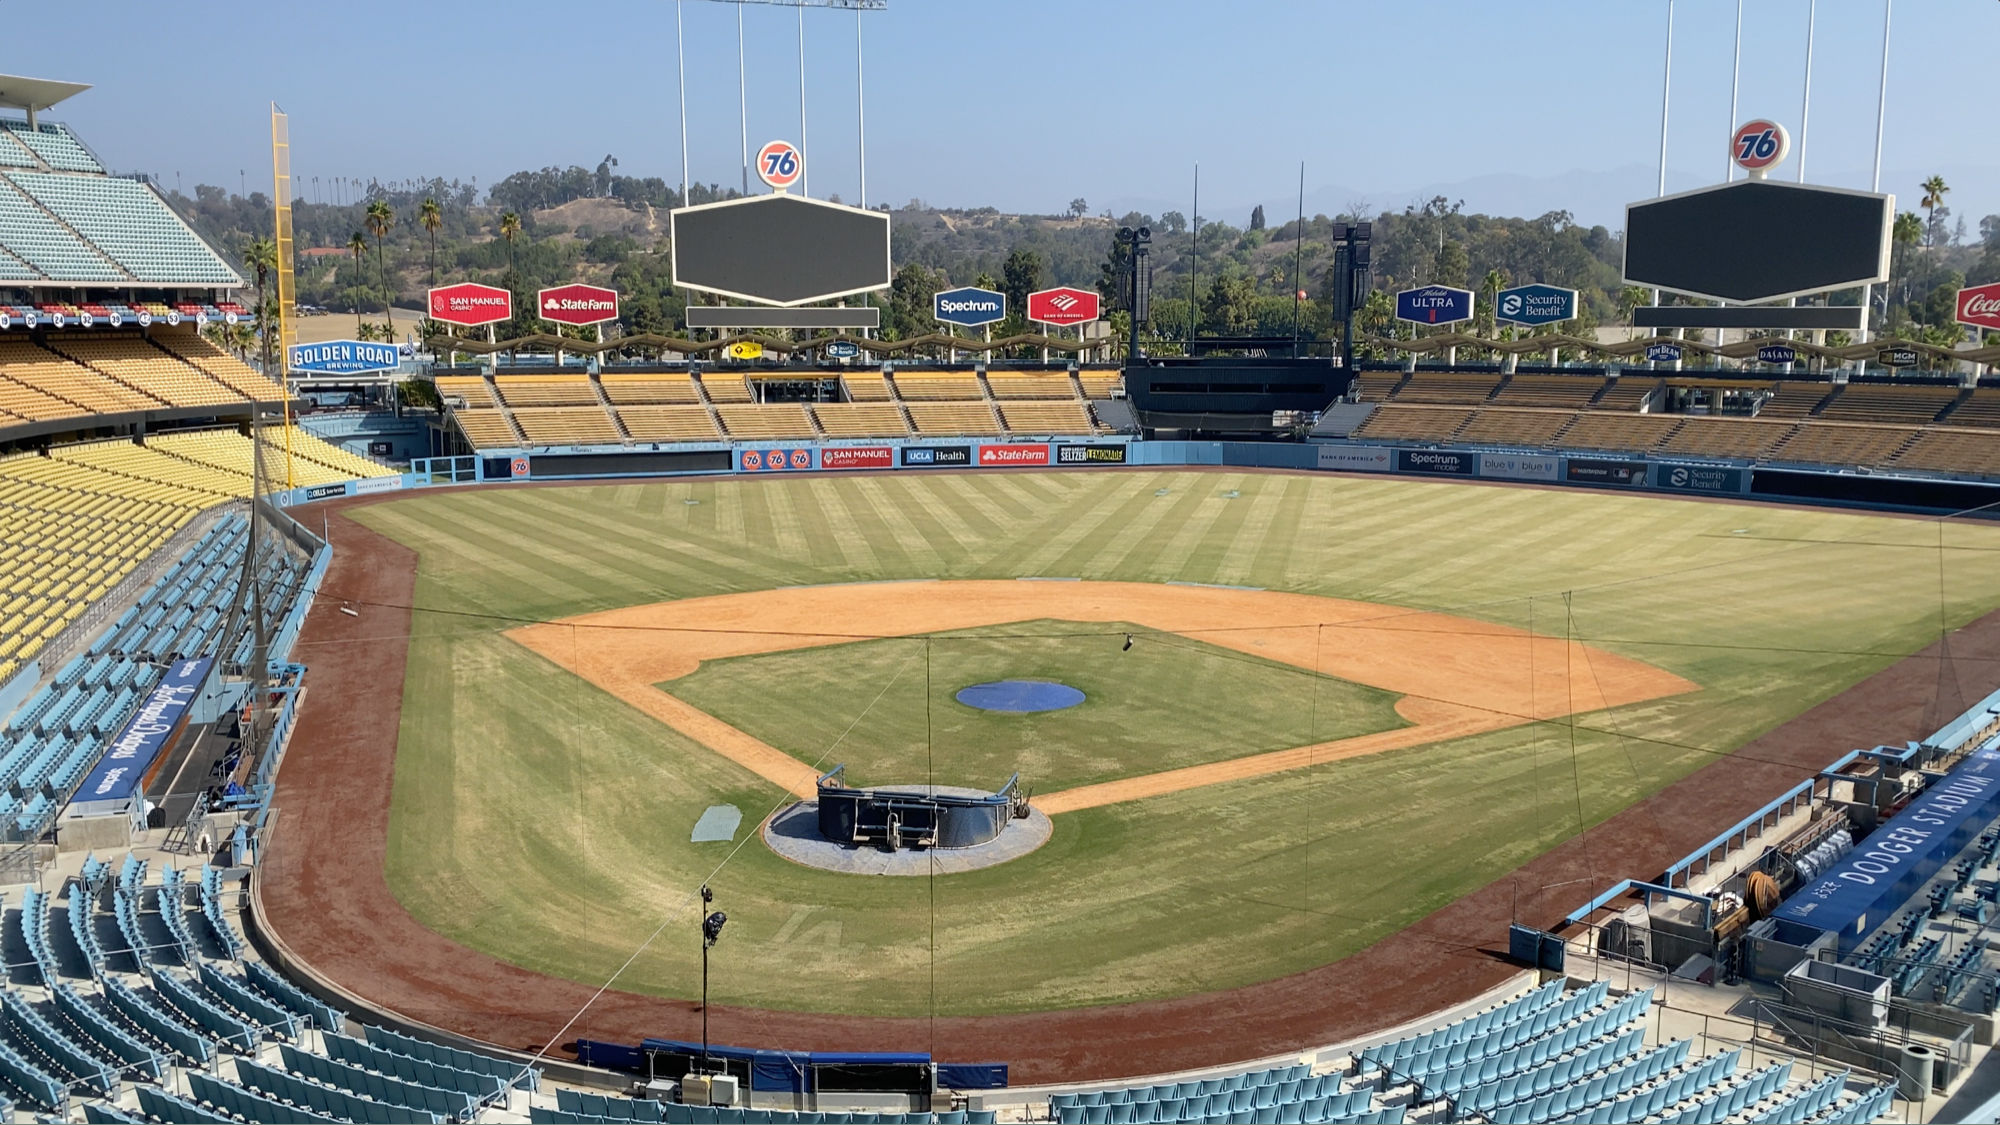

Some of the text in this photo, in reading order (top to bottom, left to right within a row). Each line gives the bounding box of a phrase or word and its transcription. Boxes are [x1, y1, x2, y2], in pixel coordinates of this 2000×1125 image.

[1738, 128, 1778, 160] 76
[764, 150, 796, 176] 76
[470, 298, 506, 306] MANUEL
[1412, 298, 1454, 308] ULTRA
[1526, 294, 1568, 306] Security
[940, 300, 996, 314] Spectrum
[1526, 306, 1561, 316] Benefit
[55, 315, 64, 324] 24
[83, 315, 92, 324] 32
[112, 316, 120, 324] 39
[169, 314, 178, 322] 53
[294, 345, 394, 366] GOLDEN ROAD
[1648, 346, 1679, 358] JIM BEAM
[1760, 350, 1794, 359] DASANI
[770, 454, 782, 464] 76
[794, 453, 806, 464] 76
[834, 450, 889, 458] SAN MANUEL
[936, 451, 965, 461] Health
[1060, 450, 1087, 461] SELTZER
[1087, 449, 1123, 460] LEMONADE
[1410, 453, 1458, 464] Spectrum
[746, 455, 758, 465] 76
[1484, 460, 1505, 469] blue
[515, 462, 526, 471] 76
[1522, 461, 1543, 470] blue
[1691, 470, 1727, 482] Security
[1691, 480, 1721, 488] Benefit
[1838, 774, 1994, 885] DODGER STADIUM
